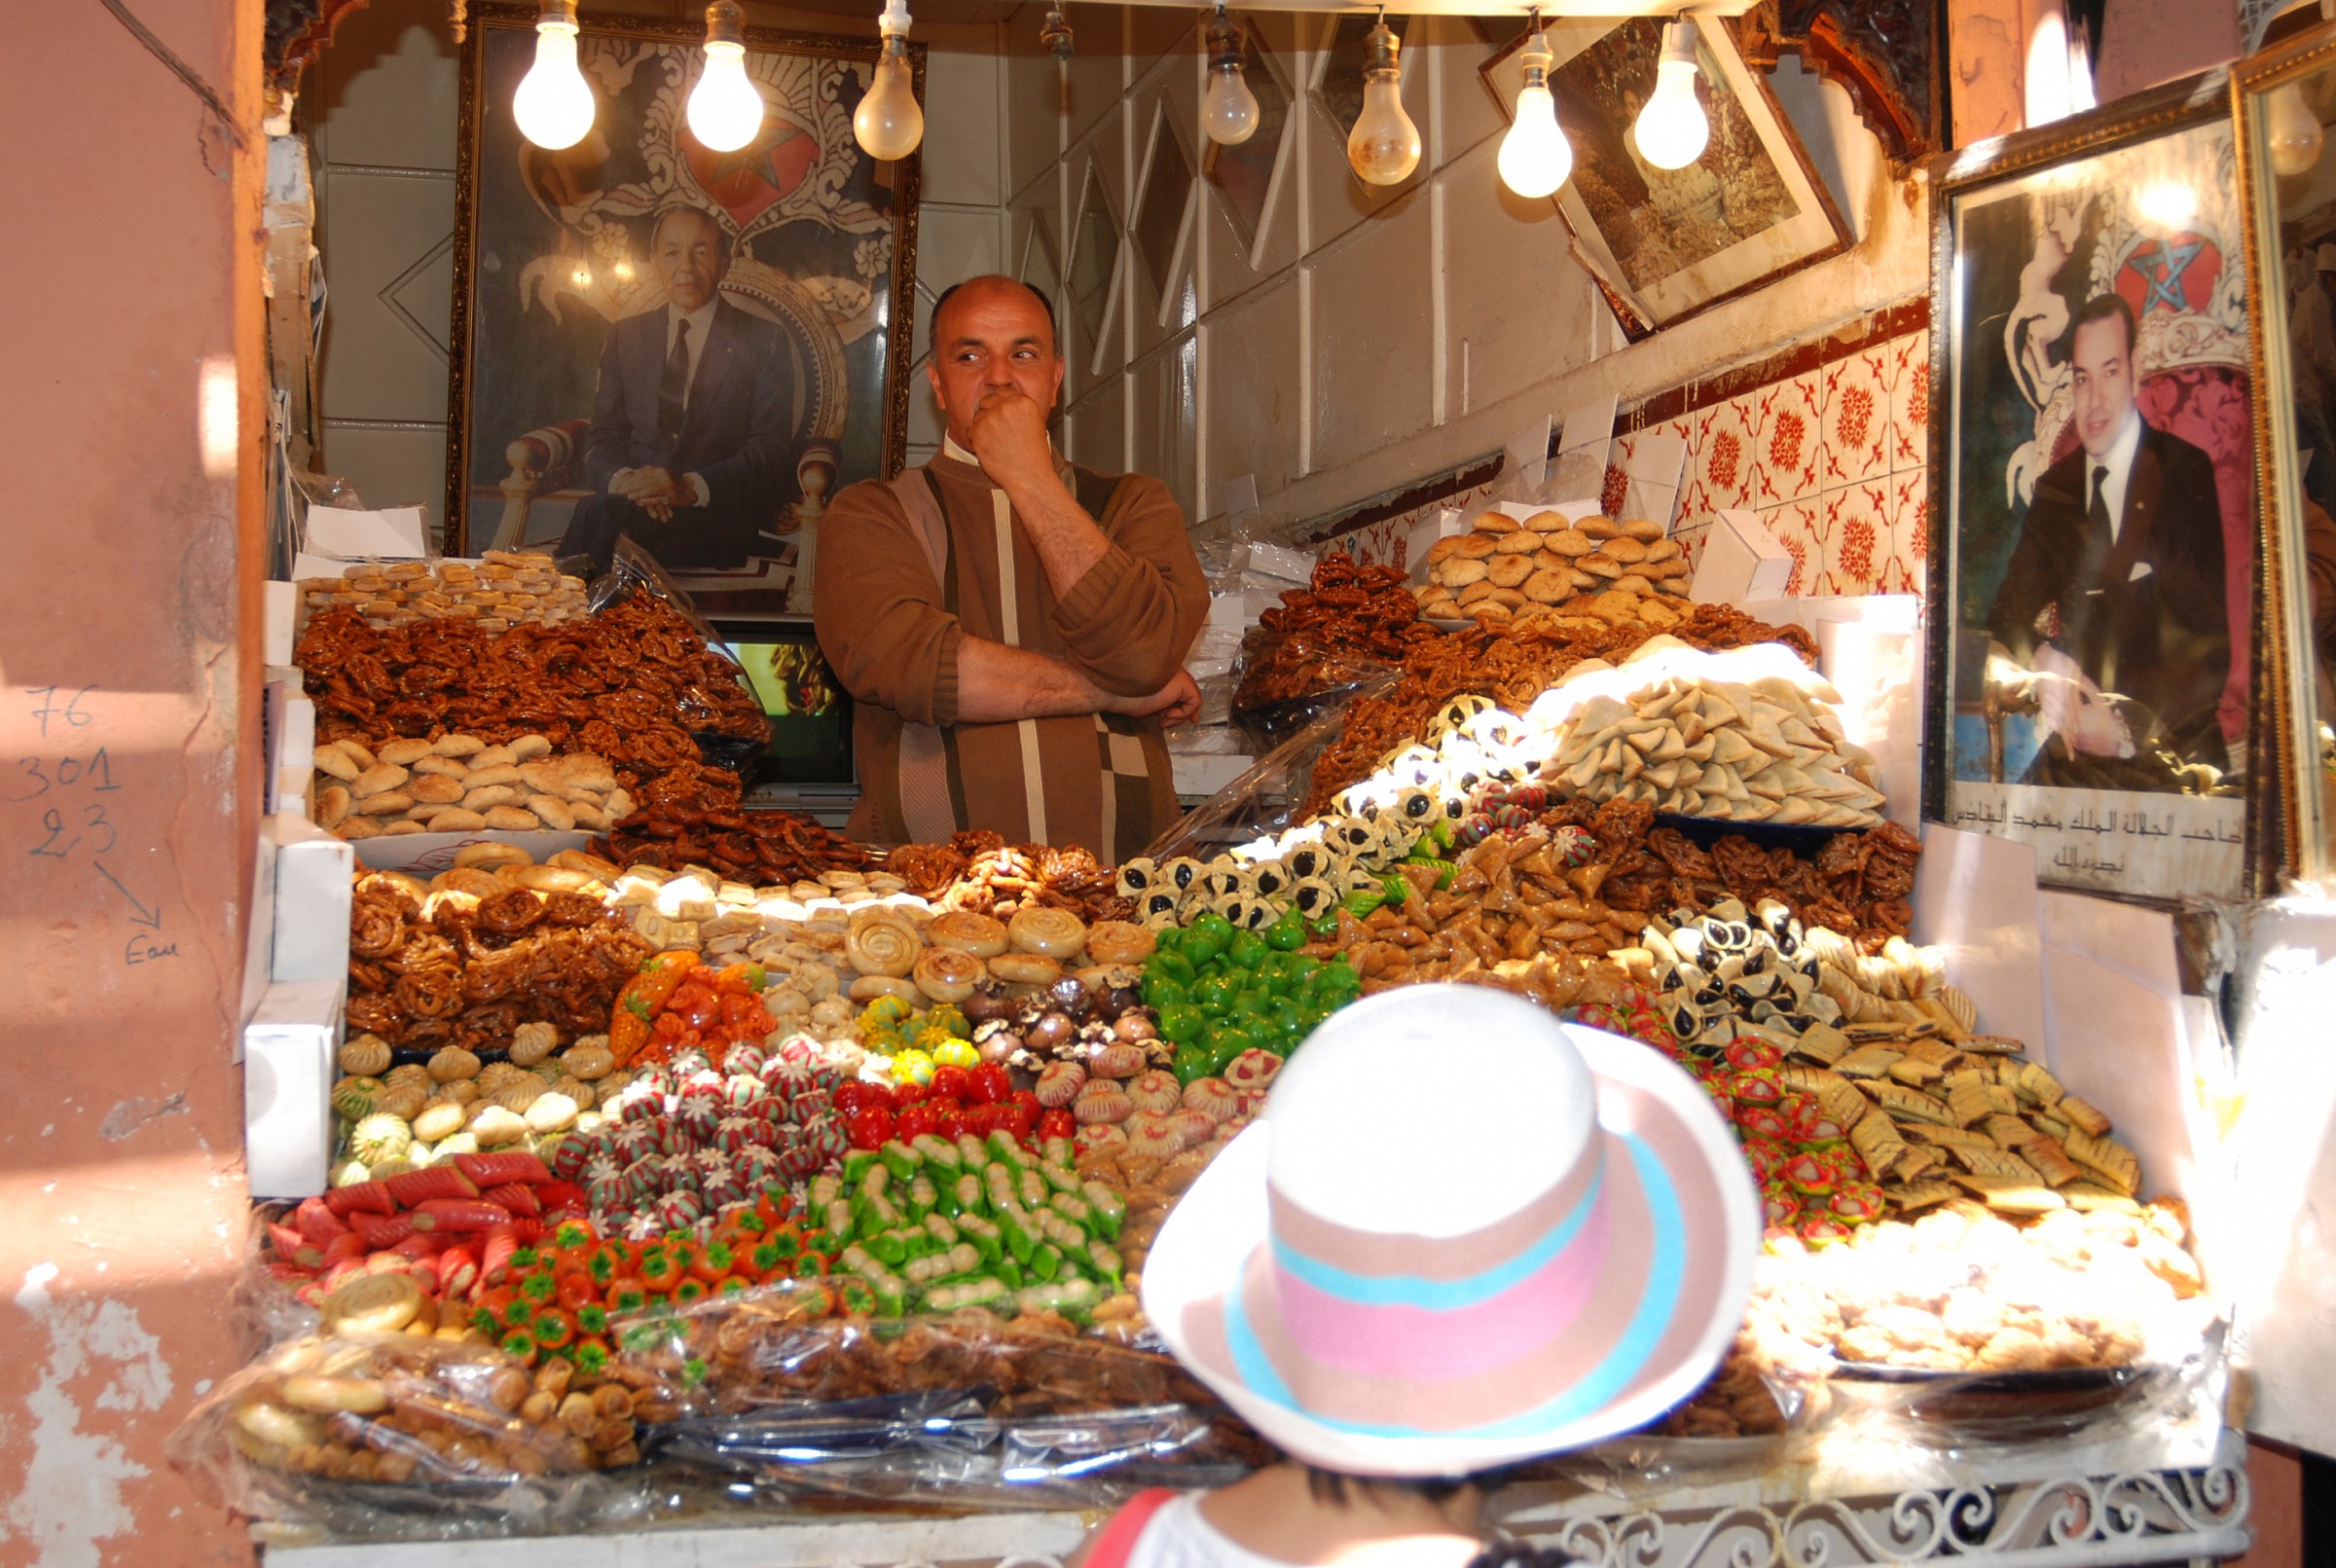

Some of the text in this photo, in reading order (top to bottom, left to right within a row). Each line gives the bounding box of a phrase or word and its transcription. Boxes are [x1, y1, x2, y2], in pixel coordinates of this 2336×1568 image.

[25, 684, 98, 738] 76
[6, 746, 122, 802] 301
[29, 804, 117, 857] 23
[2012, 813, 2062, 831] محمد
[2069, 809, 2118, 835] الملك
[2124, 810, 2173, 839] الجلالة
[2179, 817, 2242, 844] صاحب
